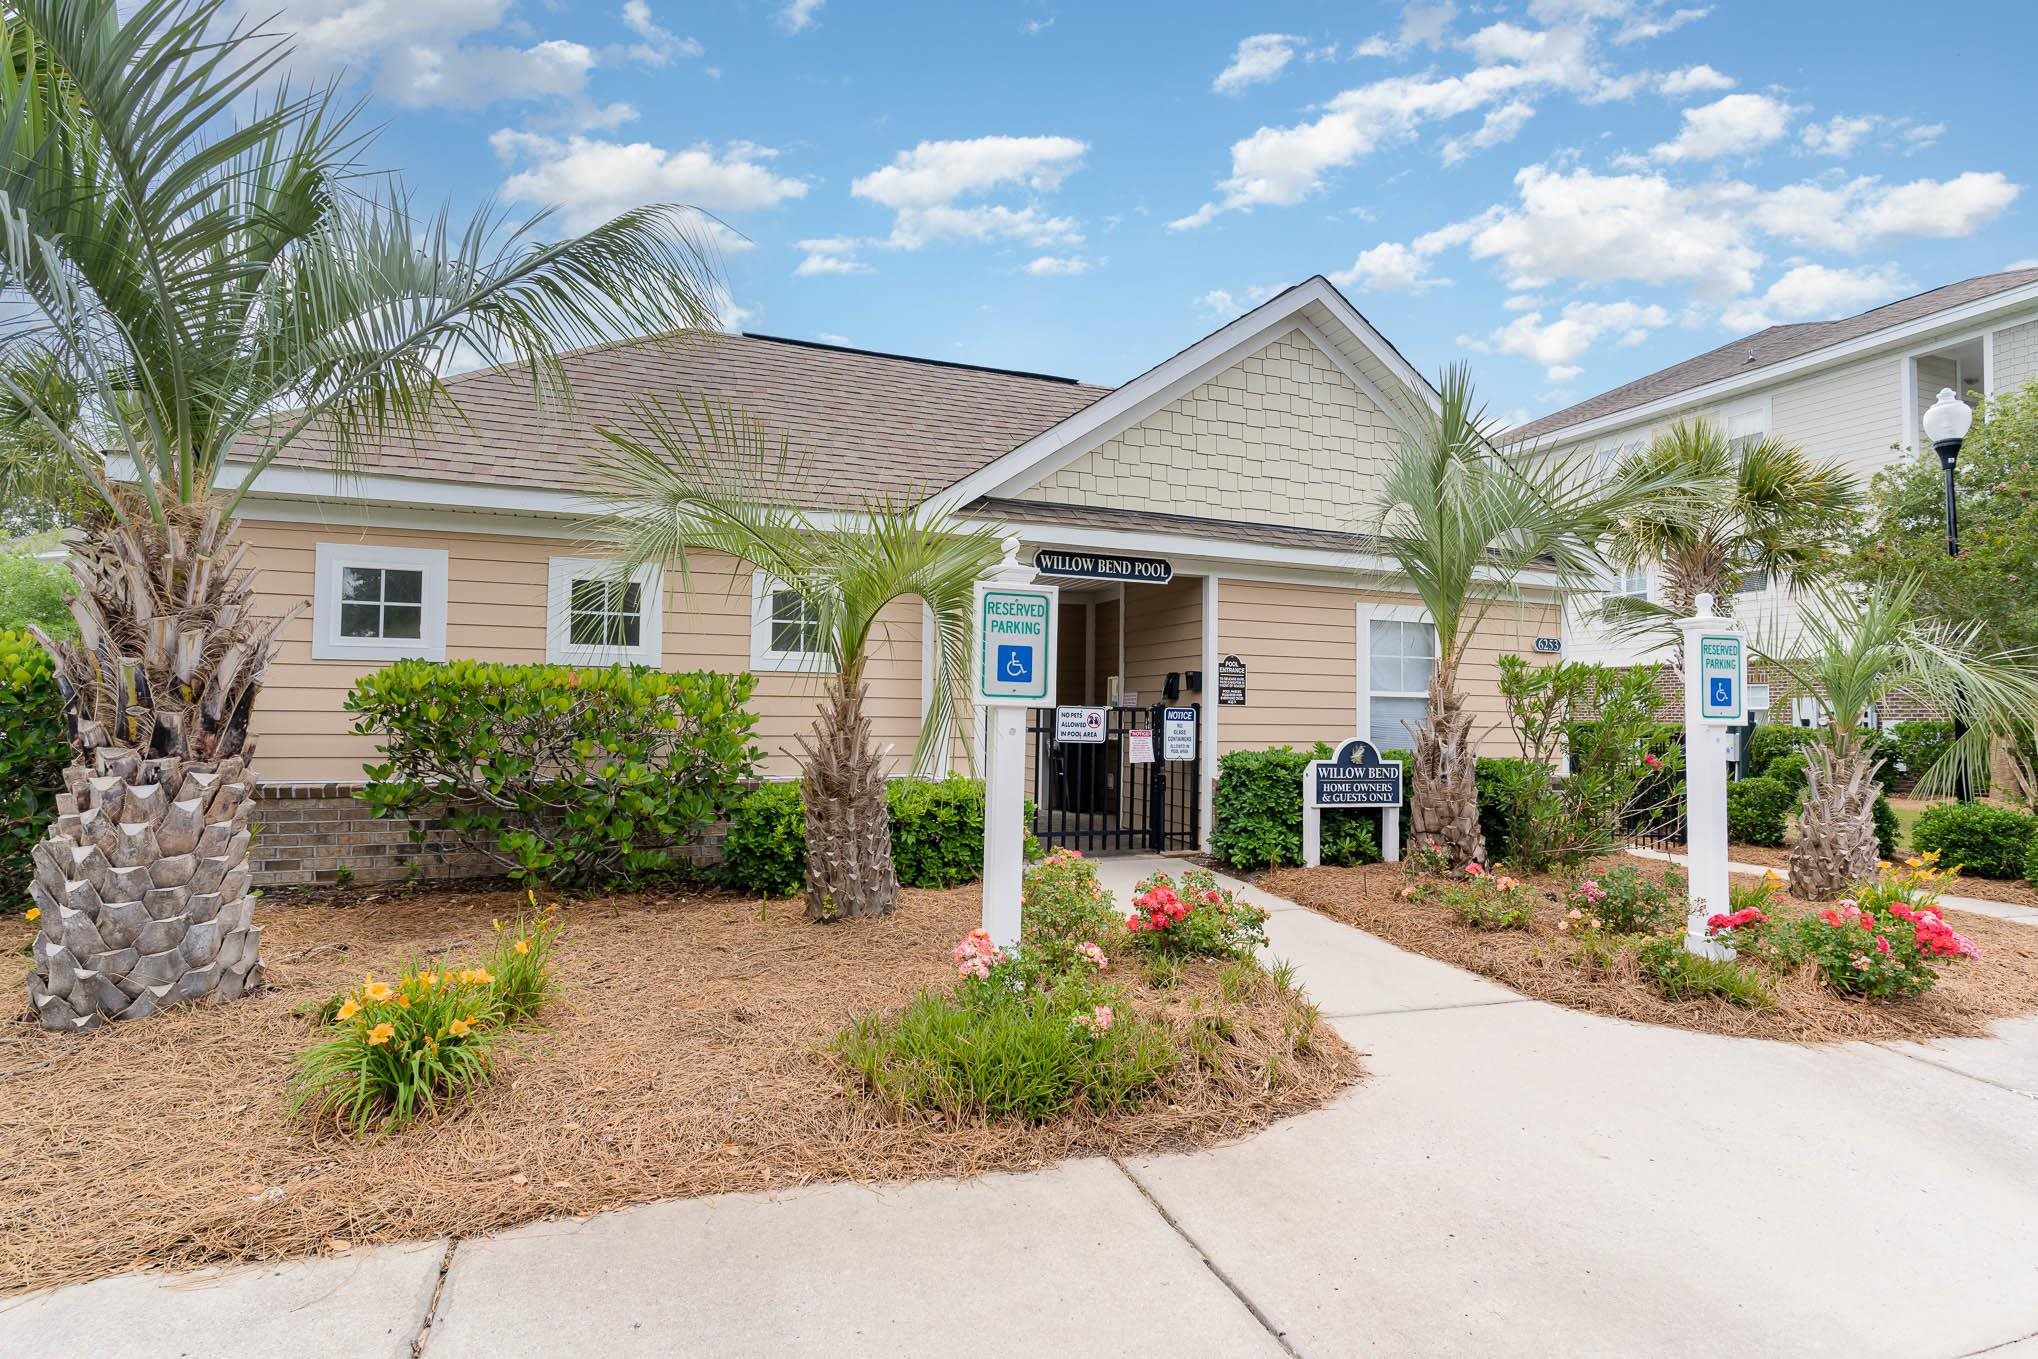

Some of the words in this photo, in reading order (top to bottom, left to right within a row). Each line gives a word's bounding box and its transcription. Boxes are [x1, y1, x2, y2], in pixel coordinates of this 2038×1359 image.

[1040, 555, 1095, 572] WILLOW
[1098, 559, 1131, 575] BEND
[1134, 562, 1168, 577] POOL
[987, 601, 1045, 617] RESERVED
[991, 620, 1041, 635] PARKING
[1538, 639, 1559, 651] 6253
[1703, 644, 1738, 656] RESERVED
[1705, 658, 1736, 670] PARKING
[1167, 710, 1193, 720] NOTICE
[1318, 767, 1366, 779] WILLOW
[1368, 767, 1399, 779] BEND
[1323, 783, 1352, 792] HOME
[1353, 783, 1393, 792] OWNERS
[1322, 793, 1331, 802] &
[1332, 793, 1367, 802] GUESTS
[1369, 793, 1394, 802] ONLY
